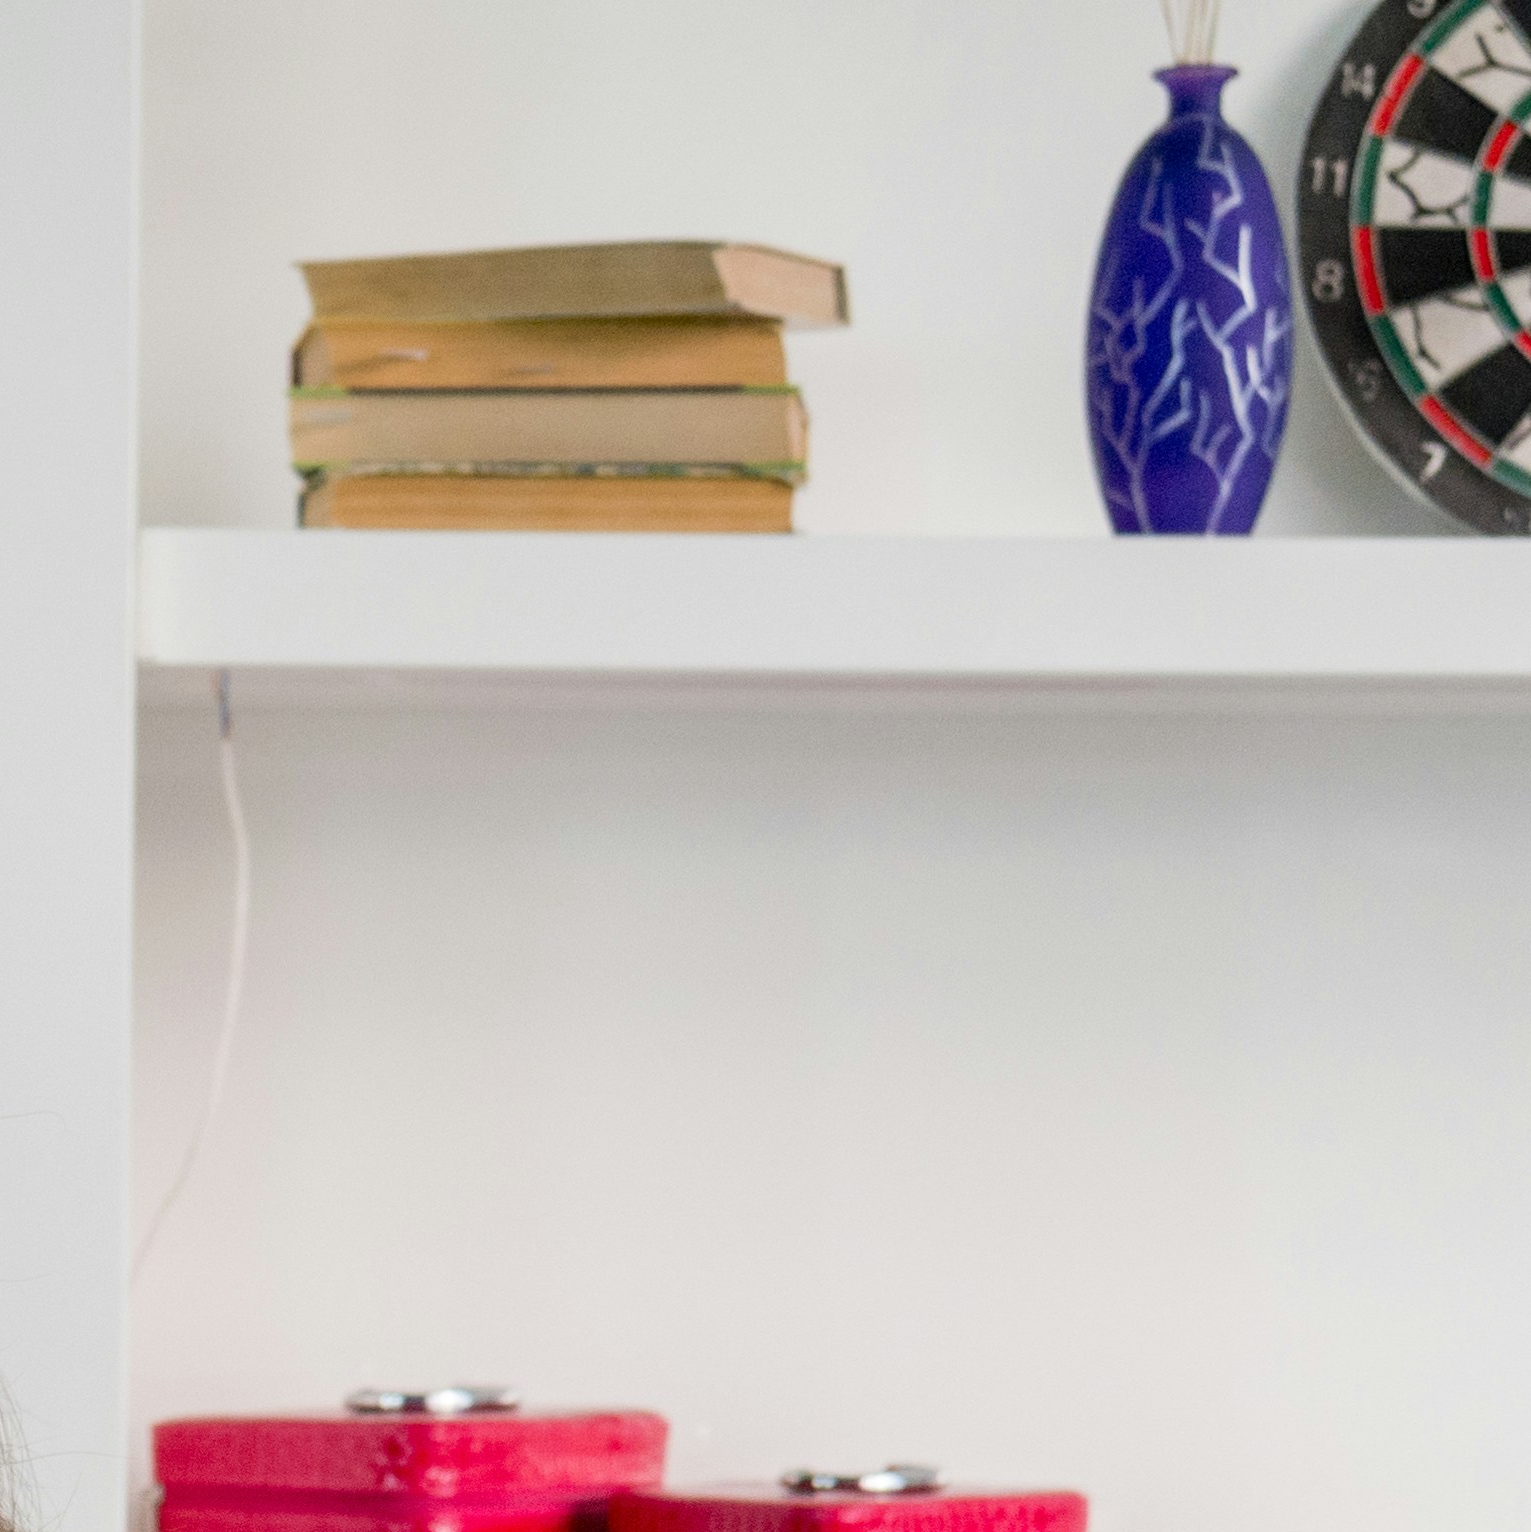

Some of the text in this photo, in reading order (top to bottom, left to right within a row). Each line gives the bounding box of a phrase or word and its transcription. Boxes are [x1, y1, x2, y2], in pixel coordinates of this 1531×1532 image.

[1311, 157, 1348, 198] 11
[1311, 258, 1344, 301] 8
[1420, 440, 1448, 485] 7
